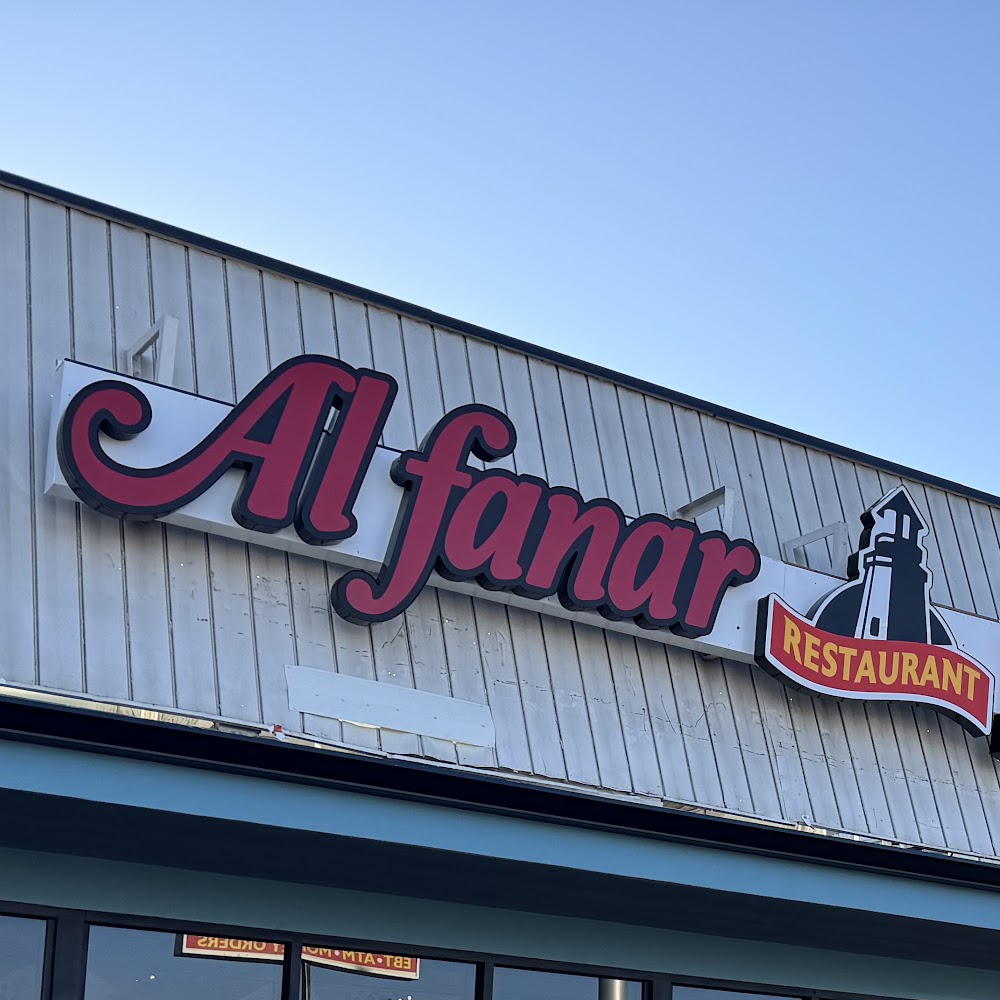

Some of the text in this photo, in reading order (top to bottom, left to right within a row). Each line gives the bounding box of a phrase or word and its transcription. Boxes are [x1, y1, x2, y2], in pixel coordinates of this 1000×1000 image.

[60, 354, 760, 638] Al fanar
[784, 614, 981, 701] RESTAURANT
